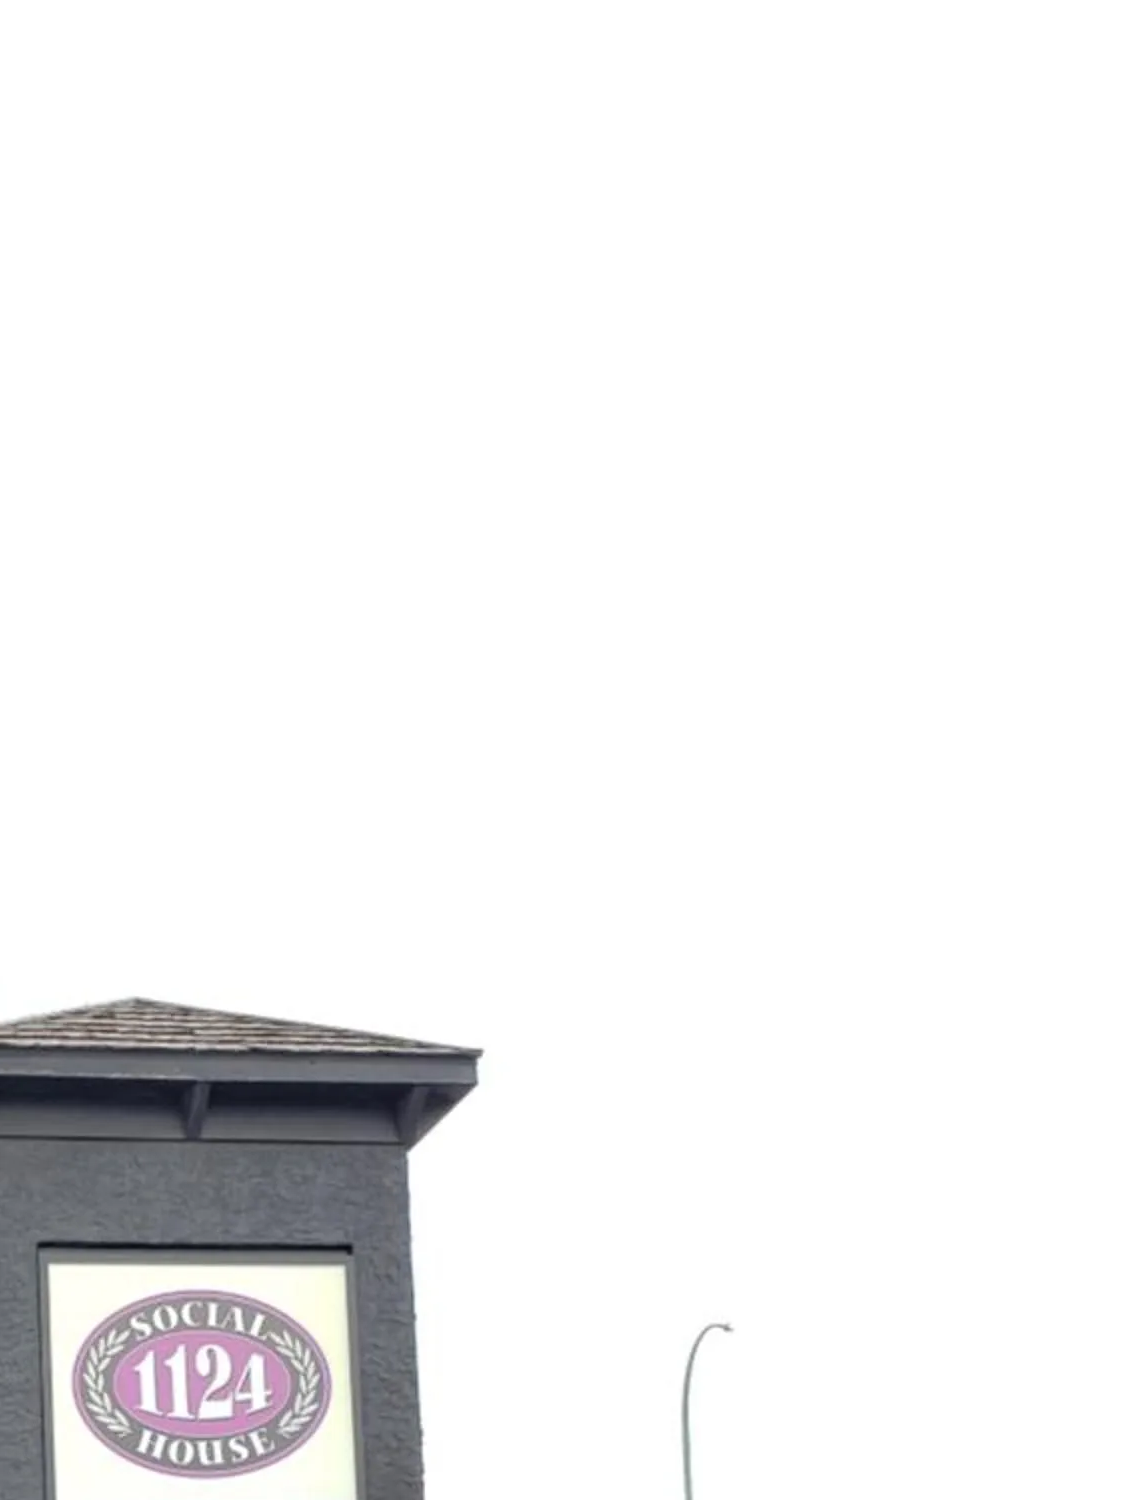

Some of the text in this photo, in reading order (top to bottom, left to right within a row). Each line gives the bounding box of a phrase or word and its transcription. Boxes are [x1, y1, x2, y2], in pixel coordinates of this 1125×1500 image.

[130, 1300, 269, 1341] SOCIAL
[134, 1344, 273, 1422] 1124
[136, 1427, 275, 1466] HOUSE
